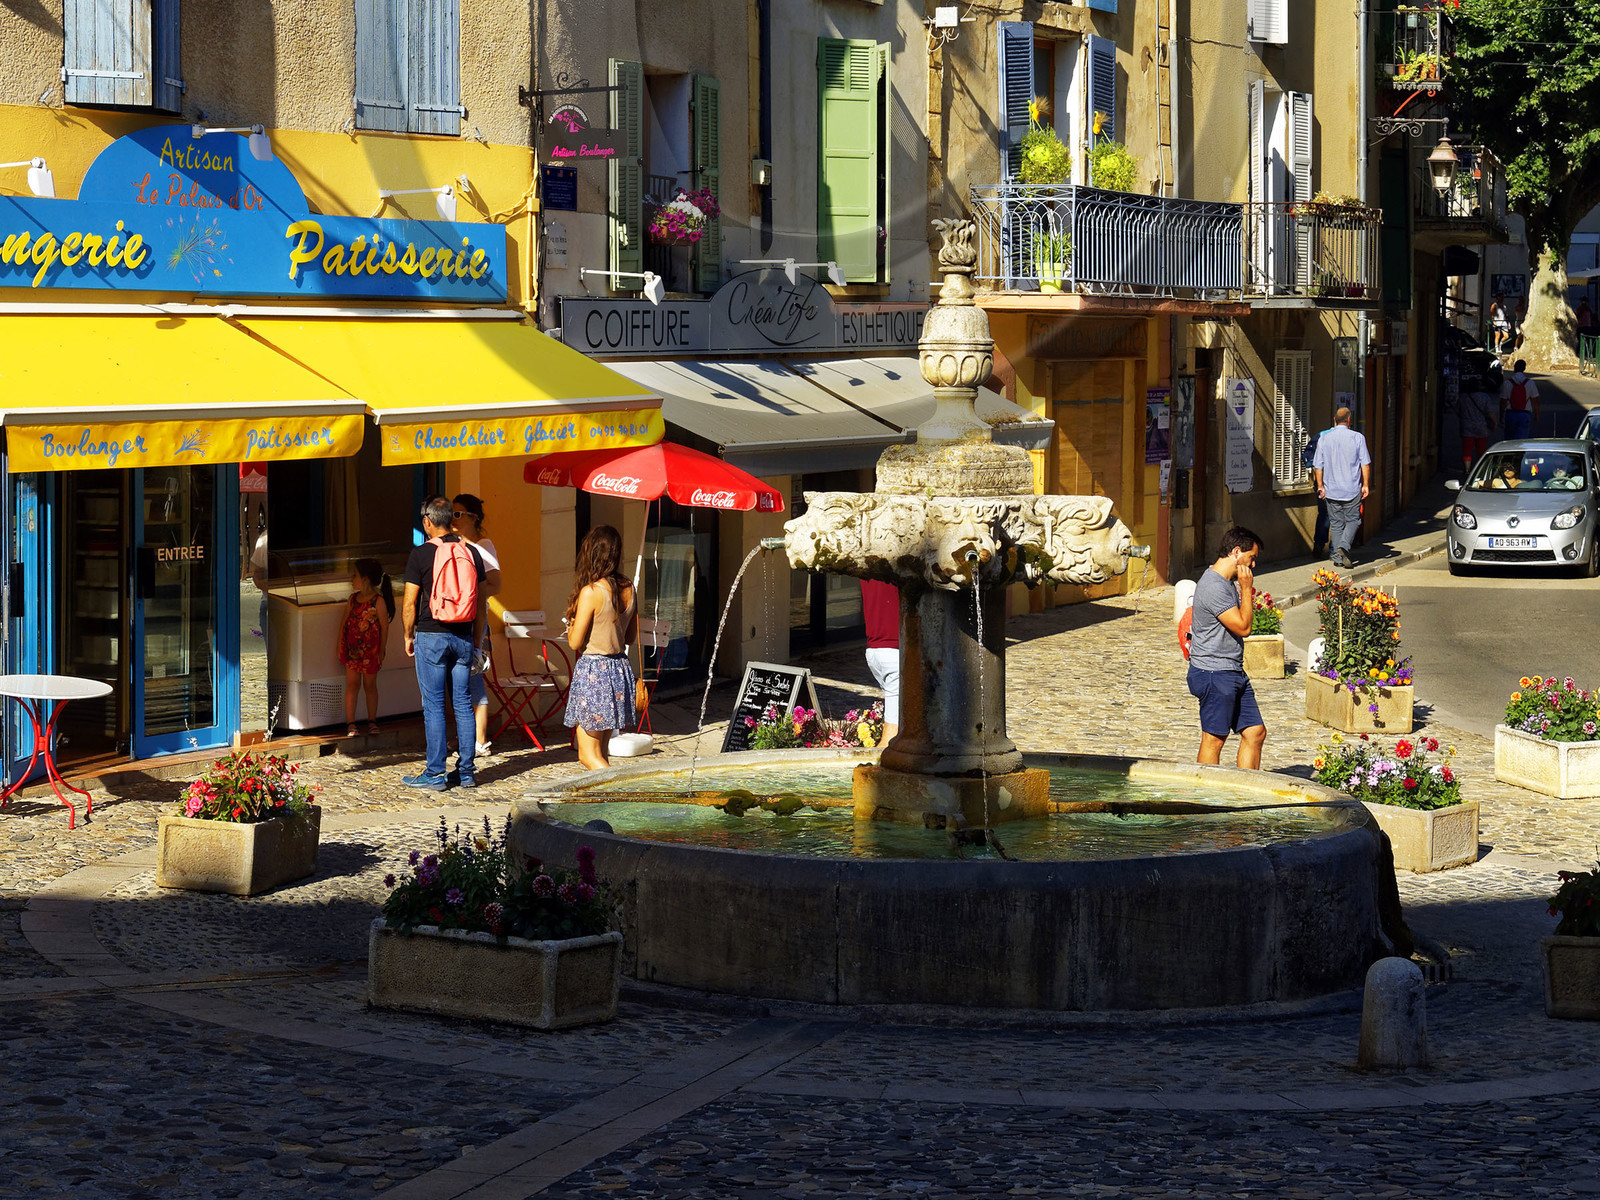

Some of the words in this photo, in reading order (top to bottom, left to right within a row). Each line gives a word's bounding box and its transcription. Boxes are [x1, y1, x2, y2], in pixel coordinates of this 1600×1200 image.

[160, 137, 234, 172] Artisan
[551, 145, 577, 158] Artisan
[579, 144, 615, 158] Boulanger
[131, 172, 159, 204] Le
[165, 173, 222, 207] Palais
[229, 183, 263, 210] d'Or
[0, 220, 146, 288] ngerie
[286, 220, 488, 279] Patisserie
[585, 309, 690, 349] COIFFURE
[843, 305, 923, 345] ESTHÉTIQUE
[40, 429, 148, 466] Boulanger
[245, 426, 334, 459] Pâtissier
[414, 425, 506, 450] Chocolatier
[524, 420, 577, 453] Glacier
[590, 426, 603, 438] 04
[604, 425, 615, 437] 92
[591, 472, 642, 494] Coca-Cola
[691, 488, 736, 507] Coca-Cola
[157, 544, 204, 561] ENTRÉE
